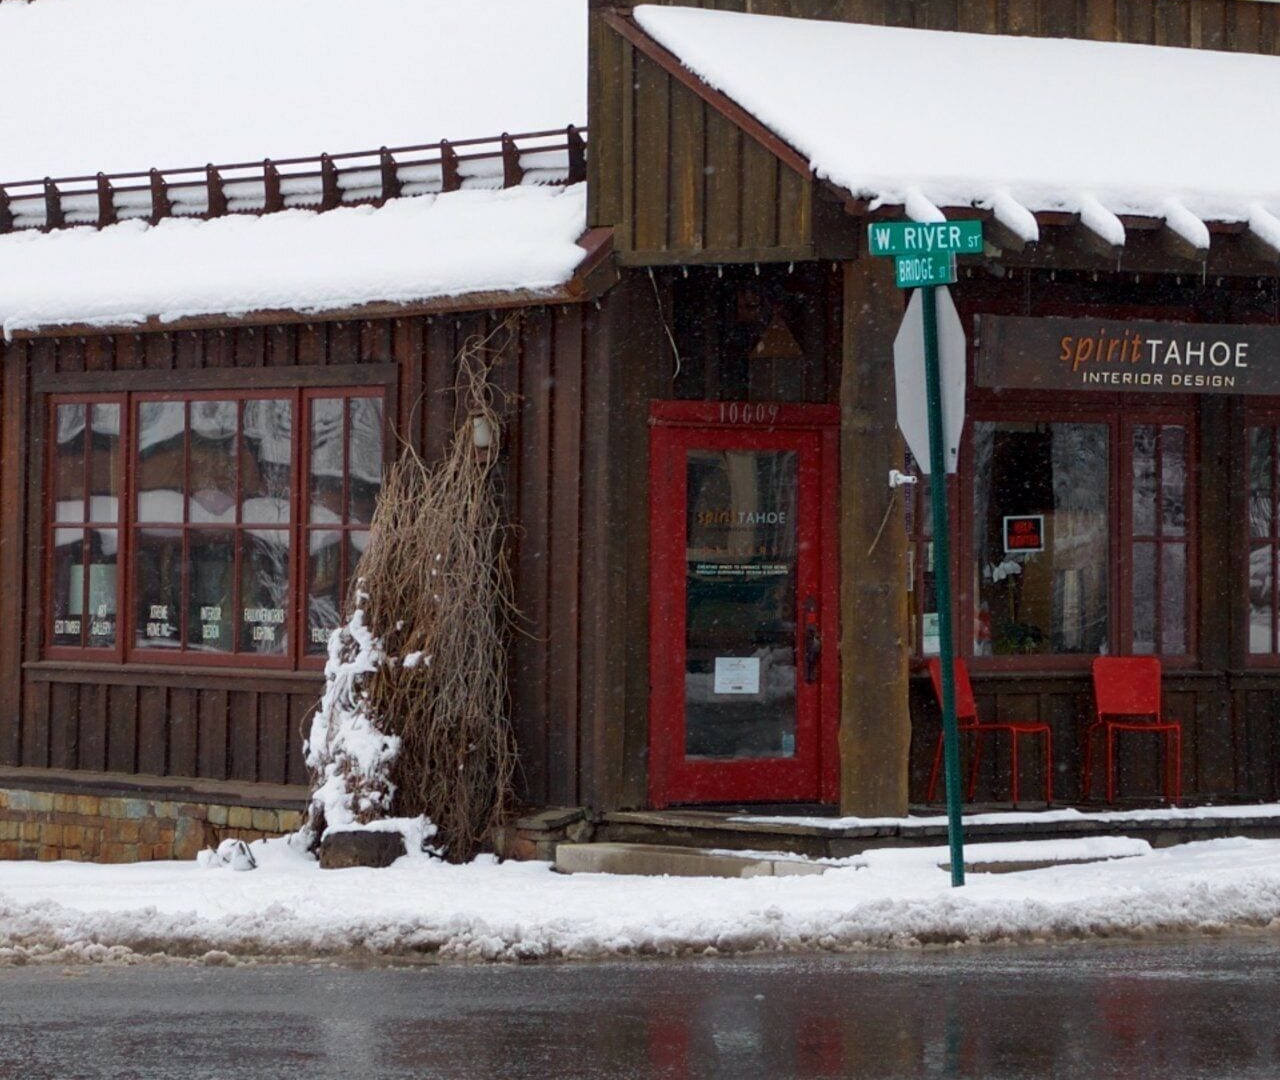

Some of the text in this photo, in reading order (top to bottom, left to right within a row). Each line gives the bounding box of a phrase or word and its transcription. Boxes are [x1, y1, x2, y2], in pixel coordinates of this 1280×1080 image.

[875, 225, 979, 250] W. RIVER ST
[899, 257, 934, 281] BRIDGE
[1059, 328, 1249, 371] spirit TAHOE
[1082, 372, 1236, 387] INTERIOR DESIGN
[738, 511, 786, 524] TAHOE
